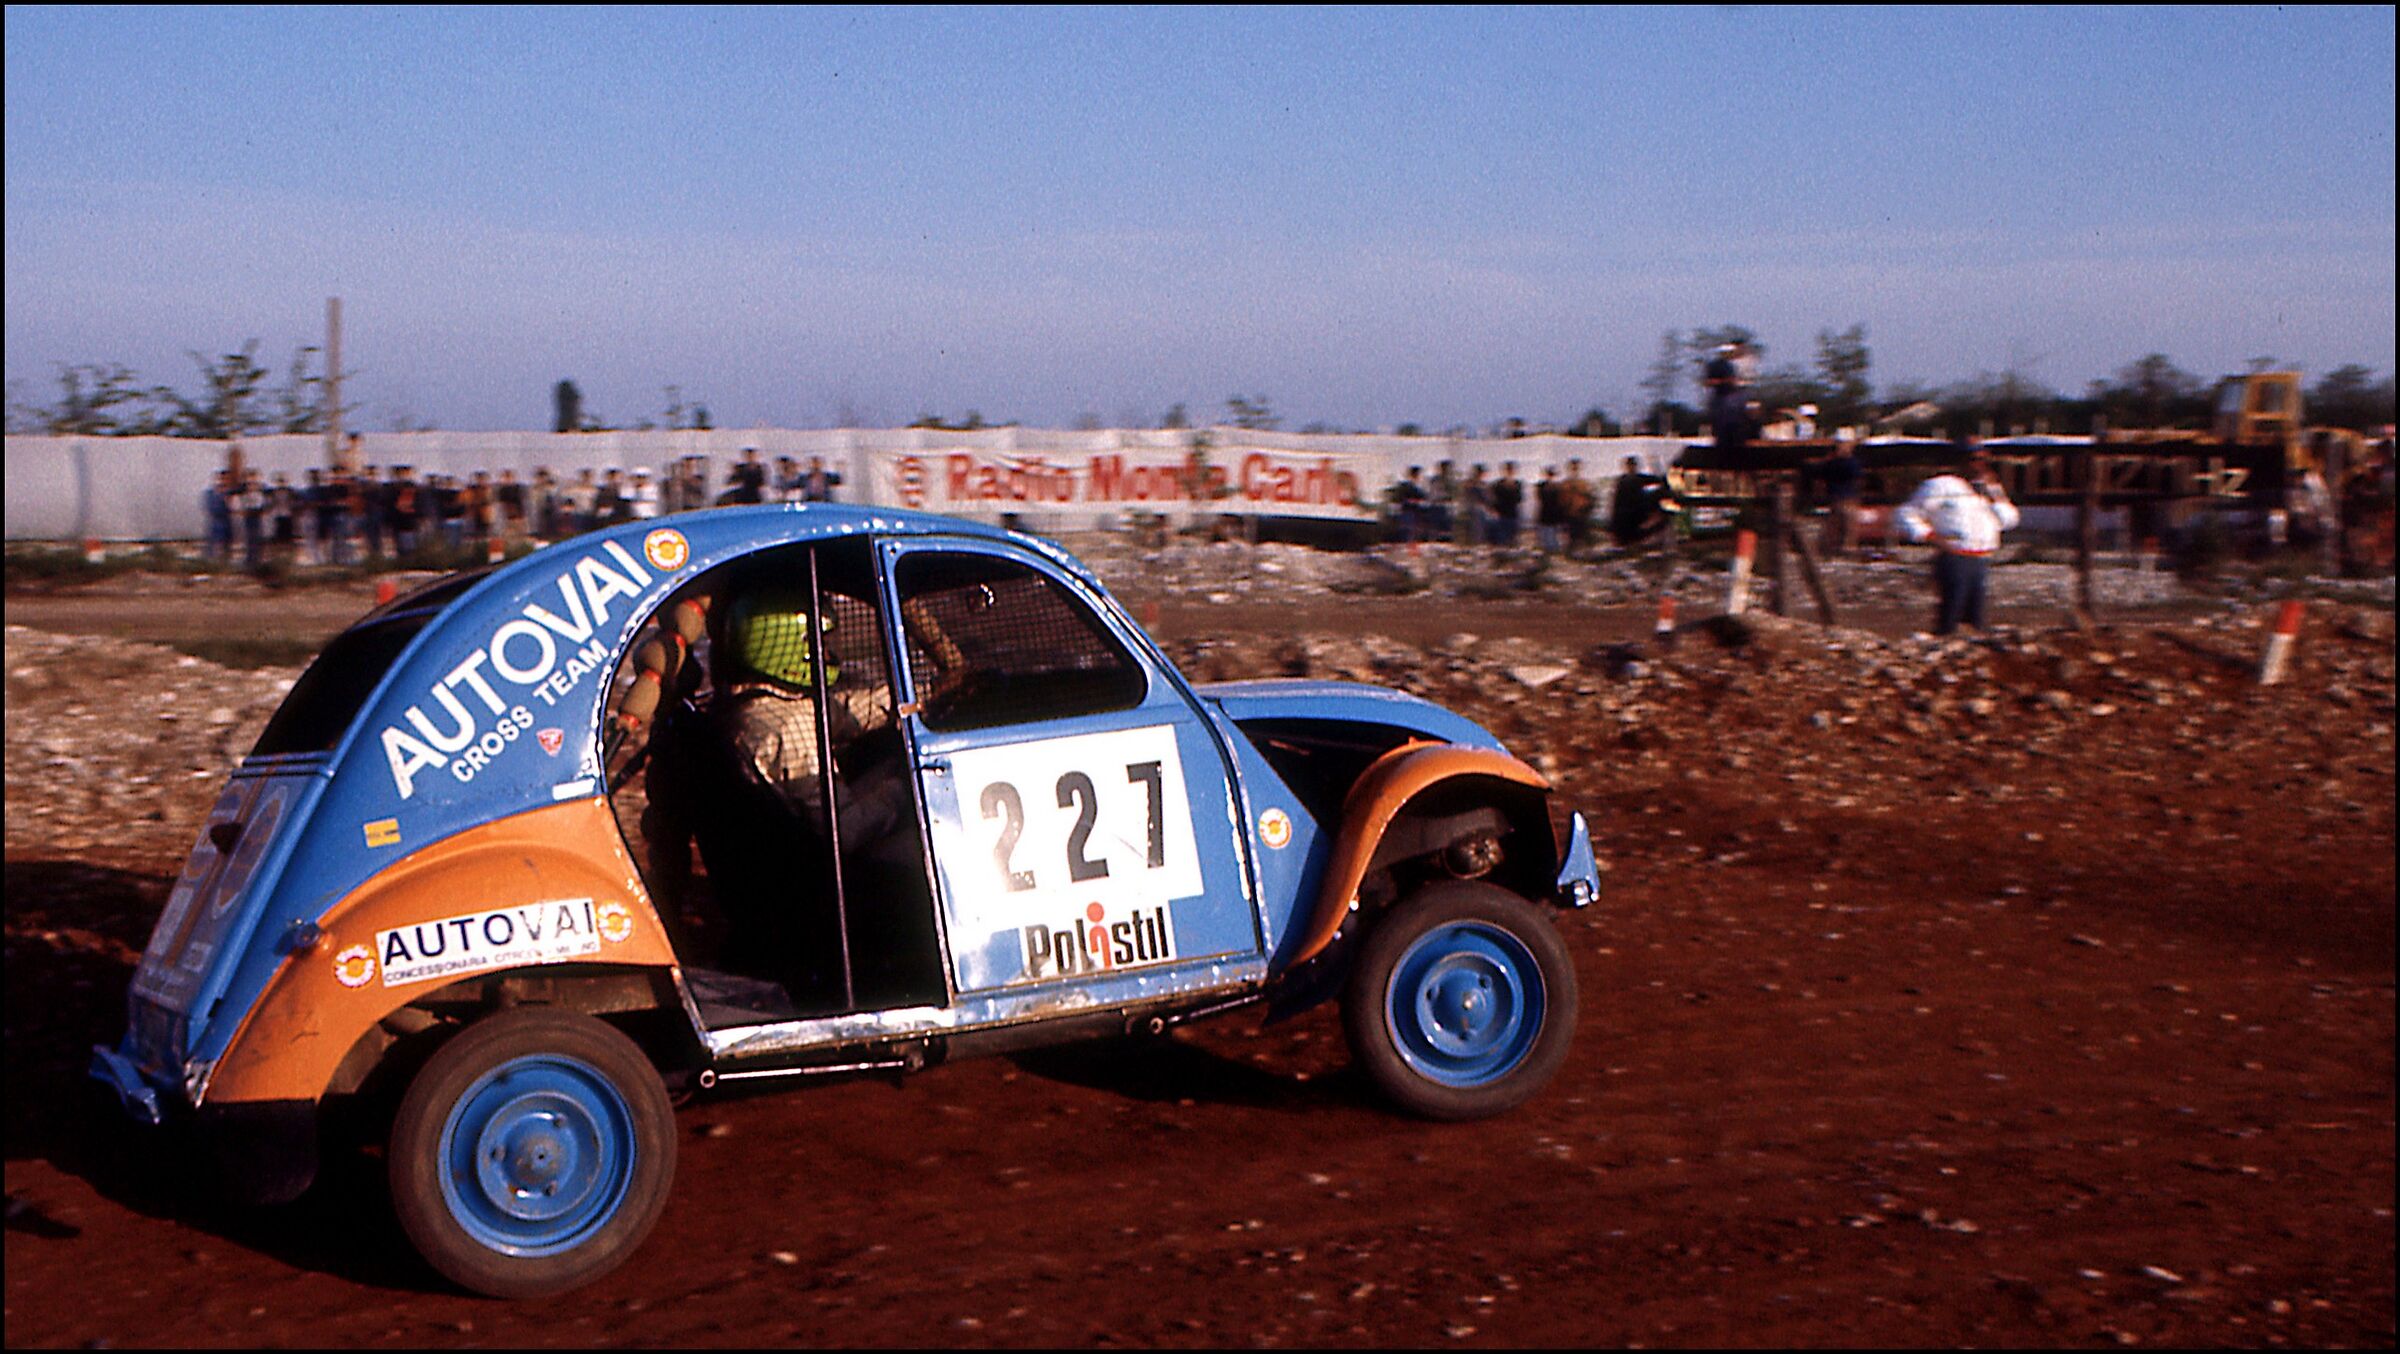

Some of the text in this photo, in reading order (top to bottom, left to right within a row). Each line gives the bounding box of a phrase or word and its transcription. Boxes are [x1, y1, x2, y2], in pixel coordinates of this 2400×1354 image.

[947, 453, 1073, 501] Radio
[1241, 453, 1358, 506] Carlo
[381, 540, 652, 799] AUTOVAI
[451, 706, 534, 782] CROSS
[533, 639, 609, 705] TEAM
[980, 760, 1164, 892] 227
[384, 902, 594, 966] AUTOVAI
[1025, 902, 1169, 978] Polistil
